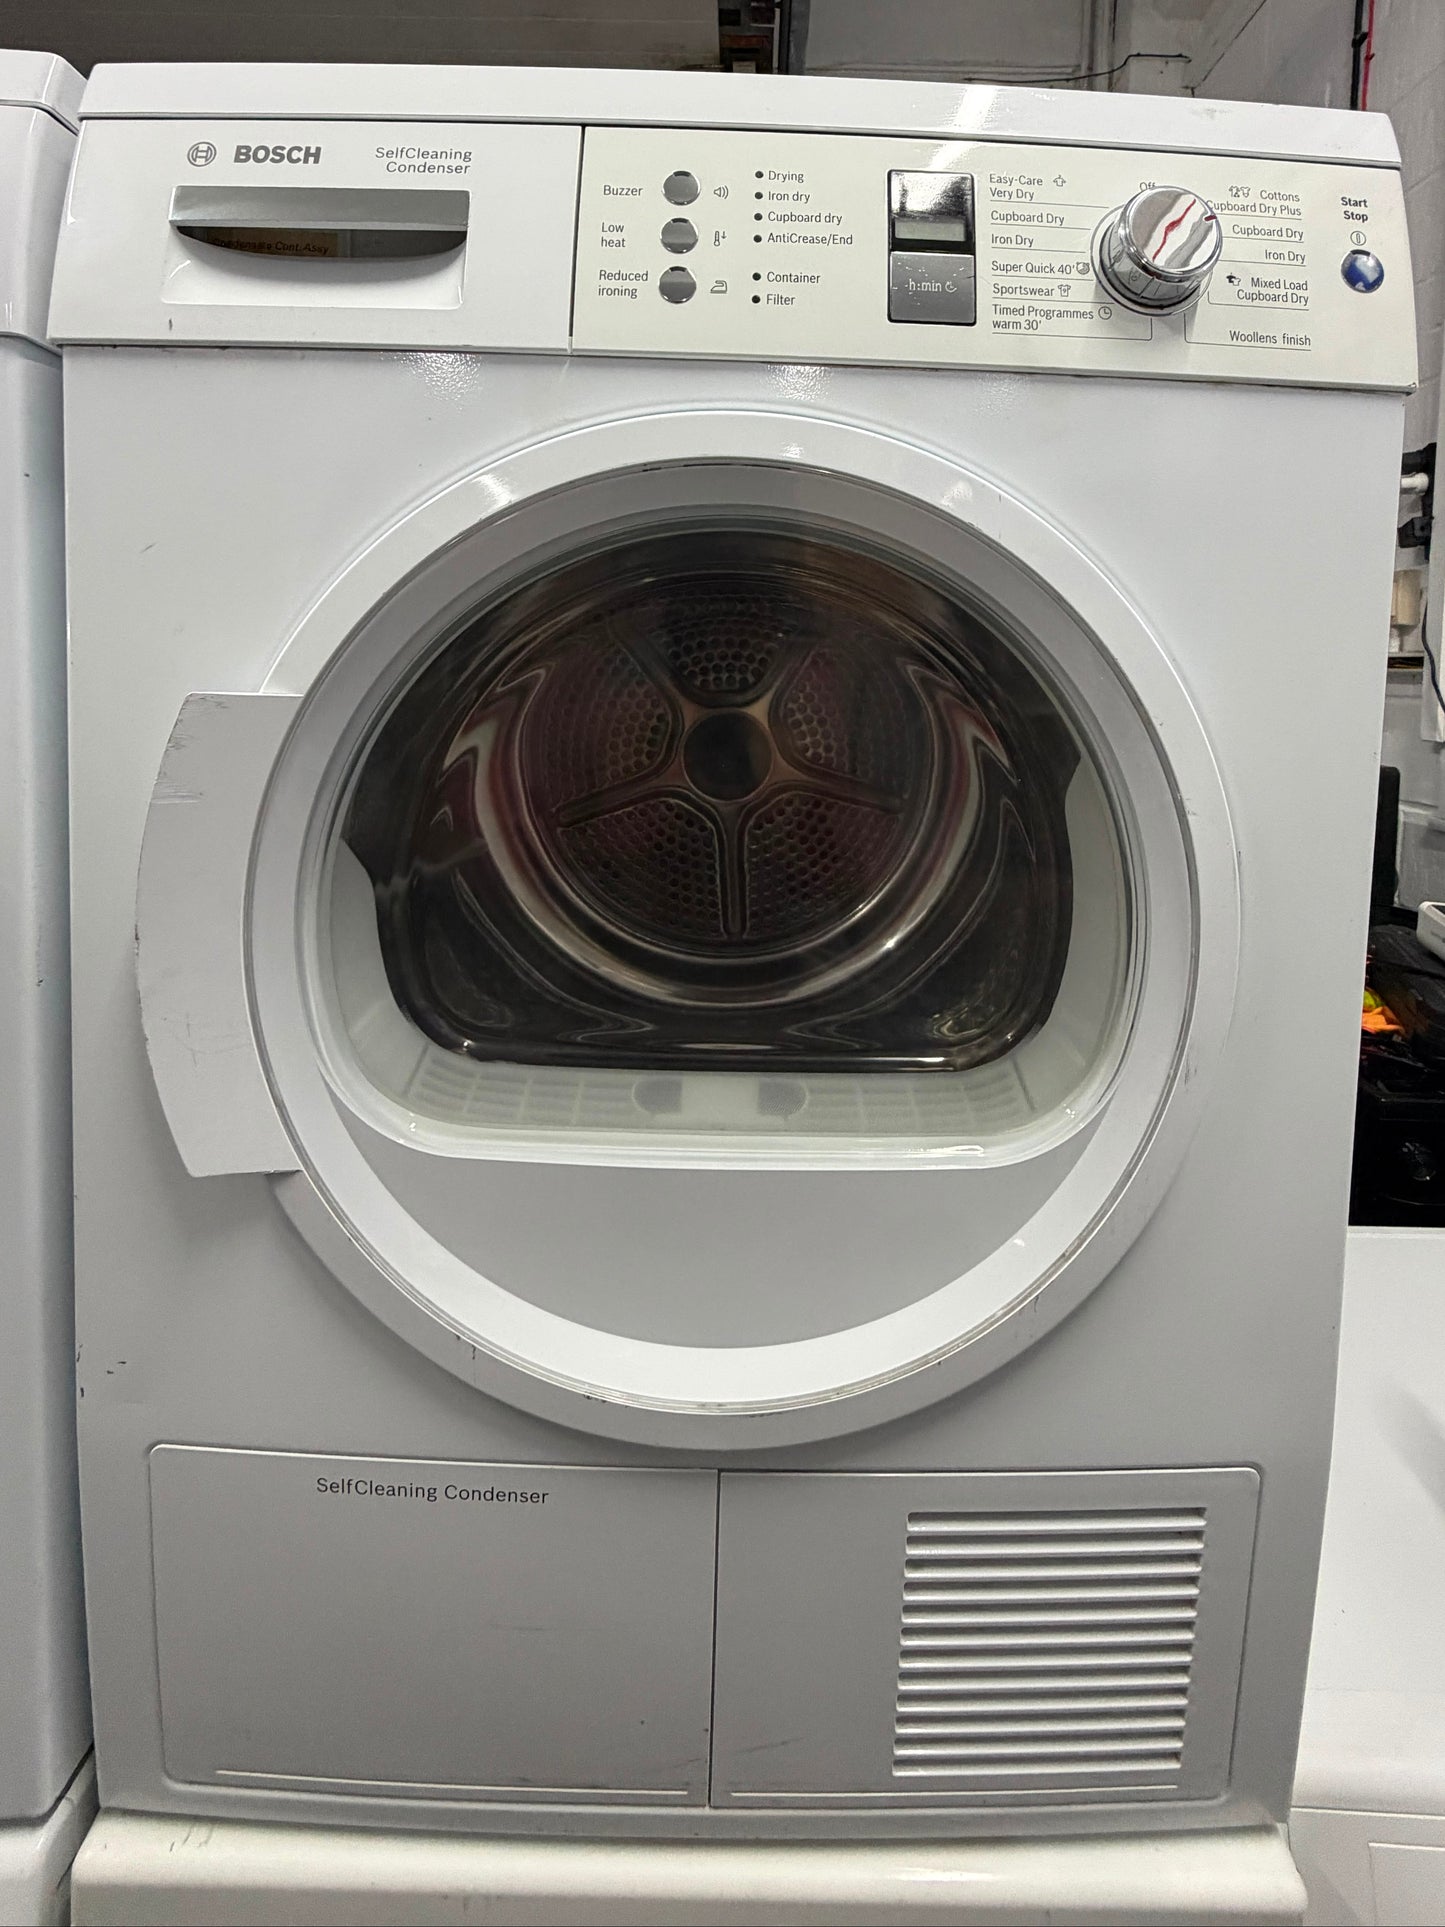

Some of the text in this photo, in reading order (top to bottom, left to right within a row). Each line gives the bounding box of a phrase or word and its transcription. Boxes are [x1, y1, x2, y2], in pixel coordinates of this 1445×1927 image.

[234, 145, 321, 164] BOSCH
[375, 147, 472, 162] SelfCleaning
[386, 161, 471, 174] Condenser
[768, 171, 804, 183] Drying
[989, 174, 1043, 186] Easy-Care
[603, 185, 643, 197] Buzzer
[989, 188, 1034, 201] Very Dry
[1260, 190, 1300, 202] Cottons
[768, 192, 810, 204] Iron dry
[1341, 197, 1368, 208] Start
[1206, 201, 1302, 216] Cupboard Dry Plus
[768, 212, 842, 226] Cupboard dry
[991, 211, 1064, 225] Cupboard Dry
[1343, 210, 1368, 223] Stop
[601, 223, 624, 234] Low
[1232, 225, 1303, 240] Cupboard Dry
[601, 237, 626, 248] heat
[767, 234, 853, 246] AntiCrease/End
[991, 235, 1034, 247] Iron Dry
[1265, 250, 1306, 263] Iron Dry
[991, 261, 1023, 274] Super
[1025, 263, 1055, 274] Quick
[599, 270, 648, 282] Reduced
[766, 272, 820, 284] Container
[992, 284, 1054, 297] Sportswear
[1251, 277, 1308, 291] Mixed Load
[598, 286, 638, 299] ironing
[1237, 289, 1309, 305] Cupboard Dry
[766, 294, 795, 305] Filter
[993, 304, 1094, 320] Timed Programmes
[992, 321, 1022, 330] warm
[1229, 331, 1311, 346] Woollens finish
[316, 1477, 549, 1504] SelfCleaning Condenser
